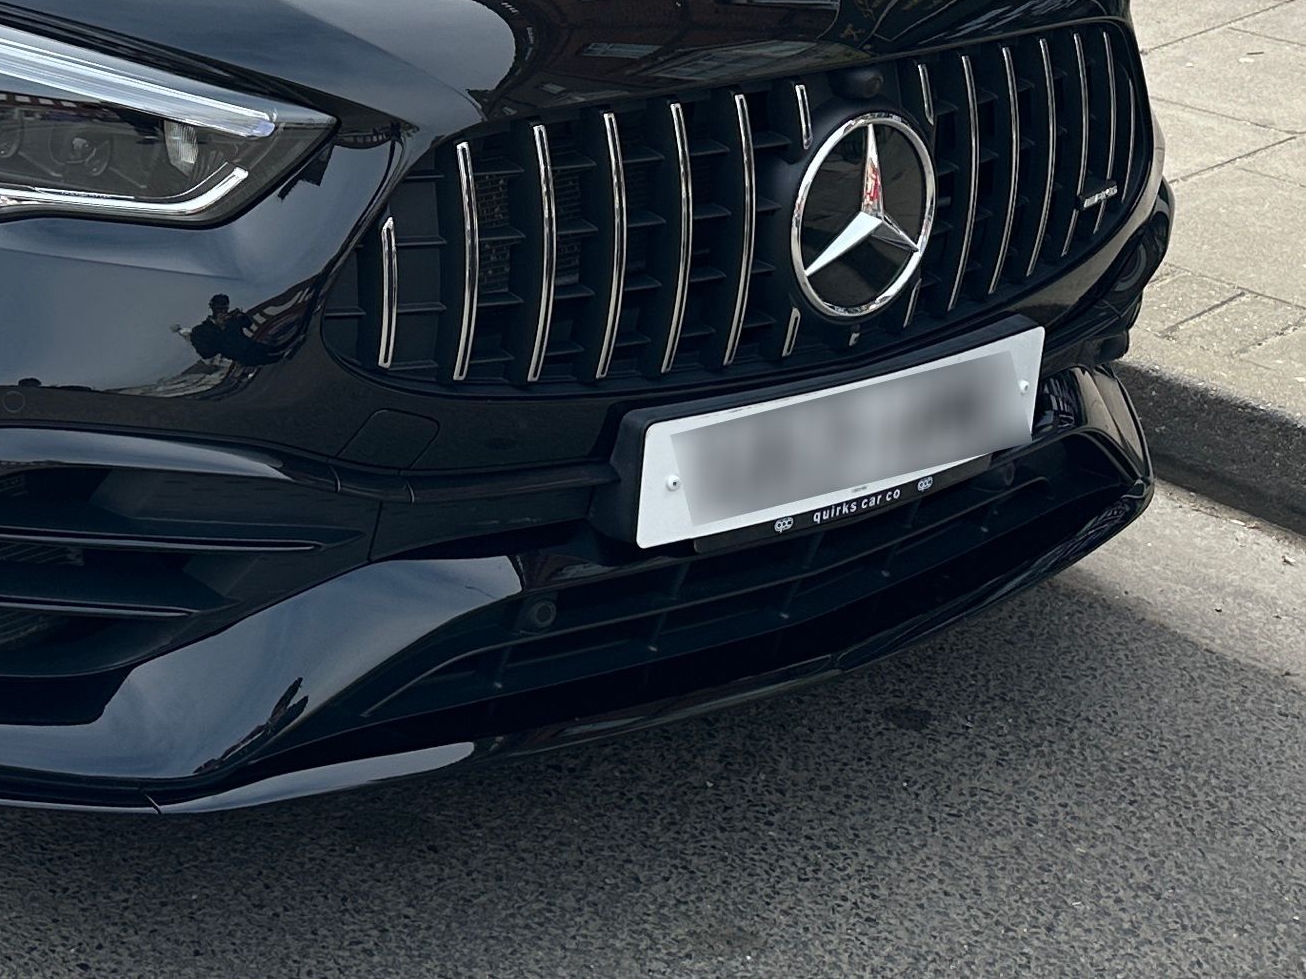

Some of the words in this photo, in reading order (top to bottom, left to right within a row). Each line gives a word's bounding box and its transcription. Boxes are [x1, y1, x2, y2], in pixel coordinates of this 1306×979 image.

[813, 500, 857, 524] quirks
[861, 493, 882, 509] car
[885, 488, 901, 502] co
